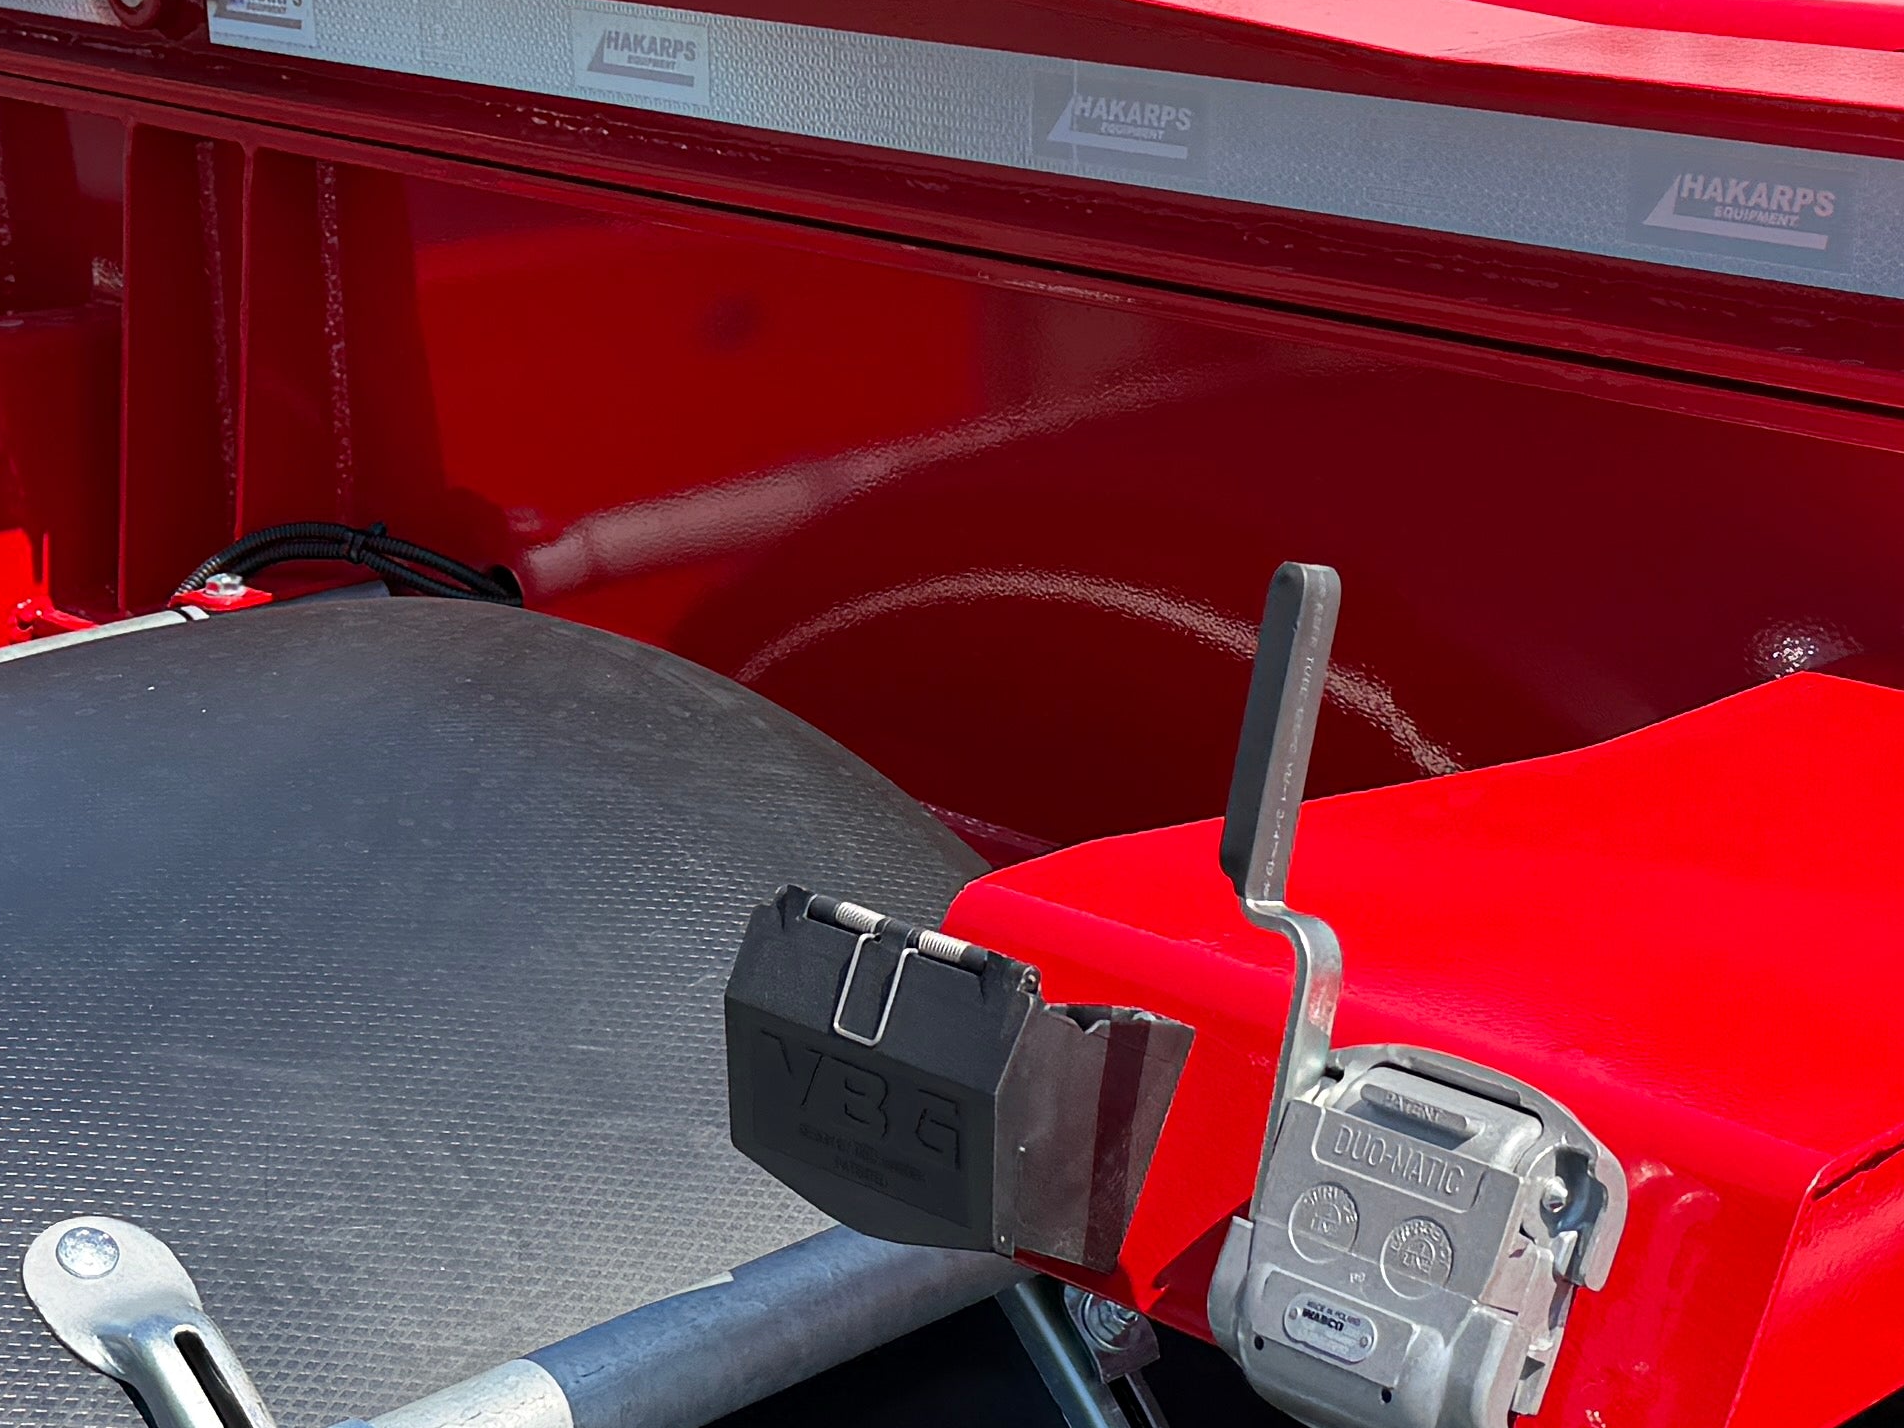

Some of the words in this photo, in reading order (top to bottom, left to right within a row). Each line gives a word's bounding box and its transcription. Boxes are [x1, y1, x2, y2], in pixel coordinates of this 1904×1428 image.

[606, 30, 697, 62] HAKARPS
[1073, 93, 1193, 131] HAKARPS
[1679, 172, 1836, 217] HAKARPS
[1713, 204, 1800, 227] EQUIPMENT
[1383, 1092, 1444, 1123] PATENT
[1334, 1124, 1464, 1194] DUO-MATIC
[1302, 1307, 1345, 1332] WABCO
